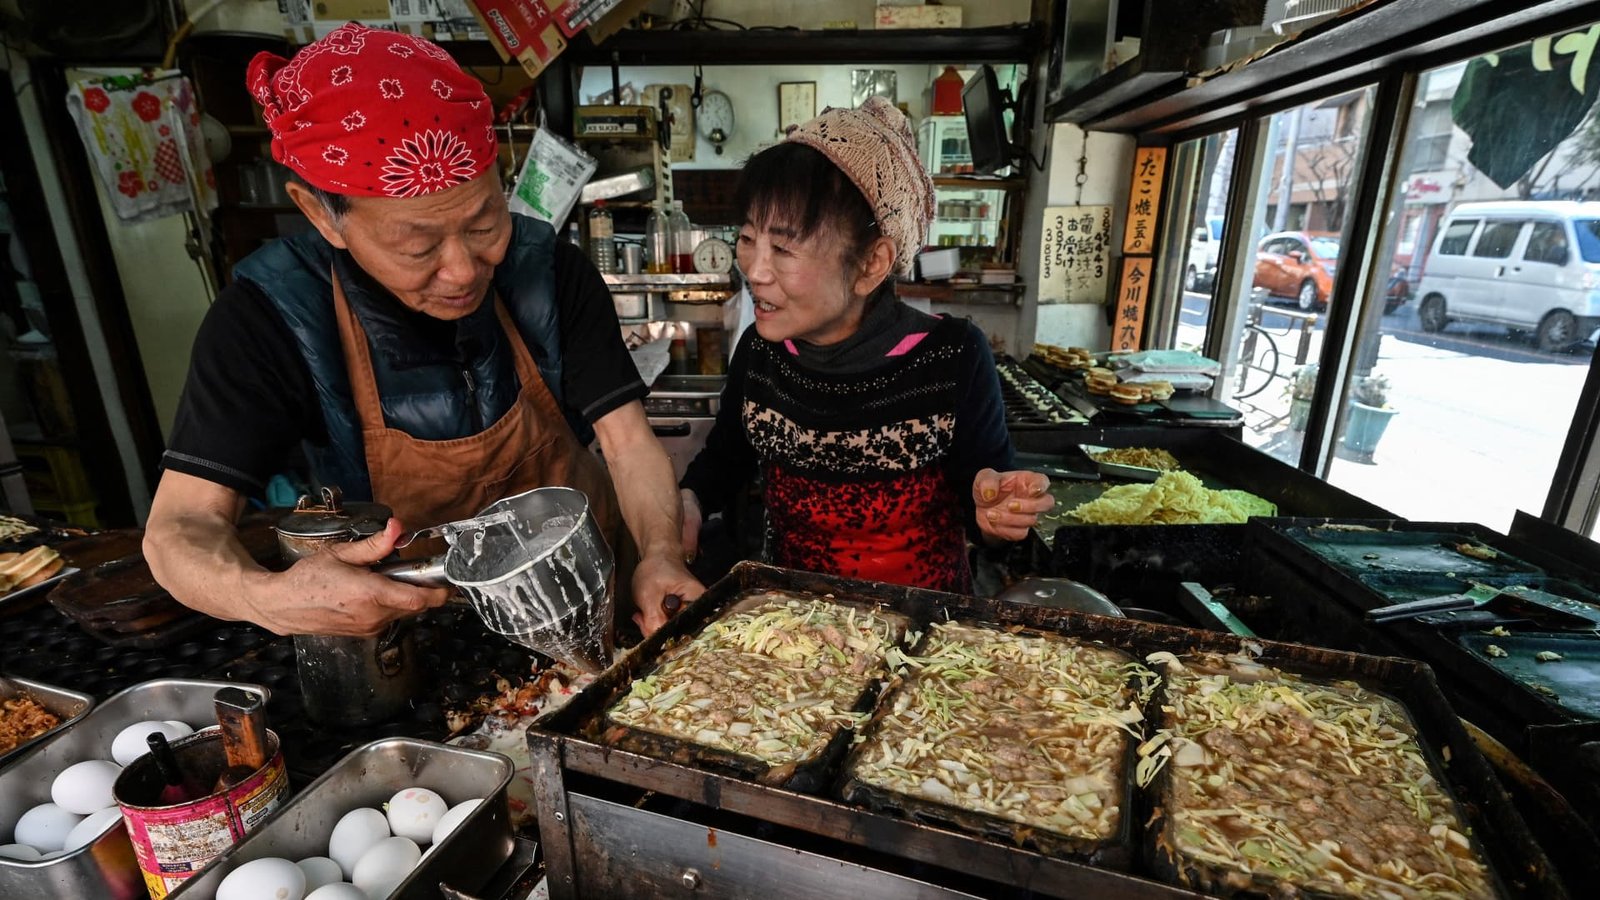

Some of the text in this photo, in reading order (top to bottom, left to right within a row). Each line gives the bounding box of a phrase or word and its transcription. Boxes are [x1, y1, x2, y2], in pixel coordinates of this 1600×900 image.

[1043, 228, 1053, 279] 3853
[1055, 215, 1064, 266] 3875
[1077, 213, 1095, 289] 電話注文
